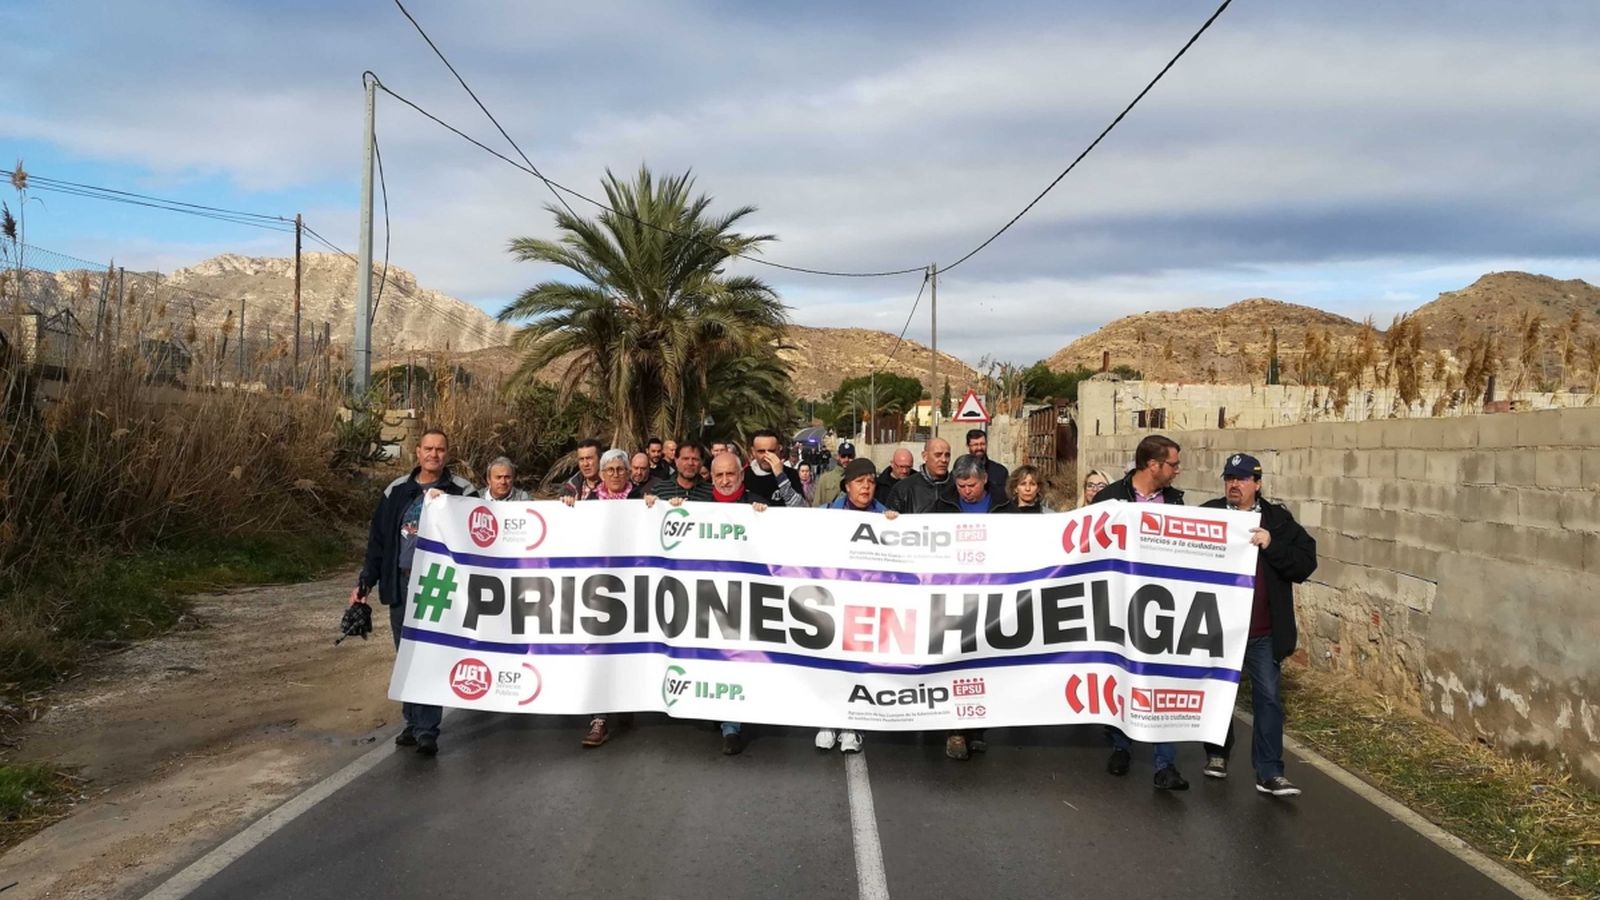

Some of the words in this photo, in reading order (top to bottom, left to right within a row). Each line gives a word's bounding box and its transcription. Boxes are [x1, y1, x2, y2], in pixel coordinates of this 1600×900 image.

[849, 522, 951, 553] Acaip
[848, 683, 949, 709] Acaip
[956, 684, 983, 696] EPSU
